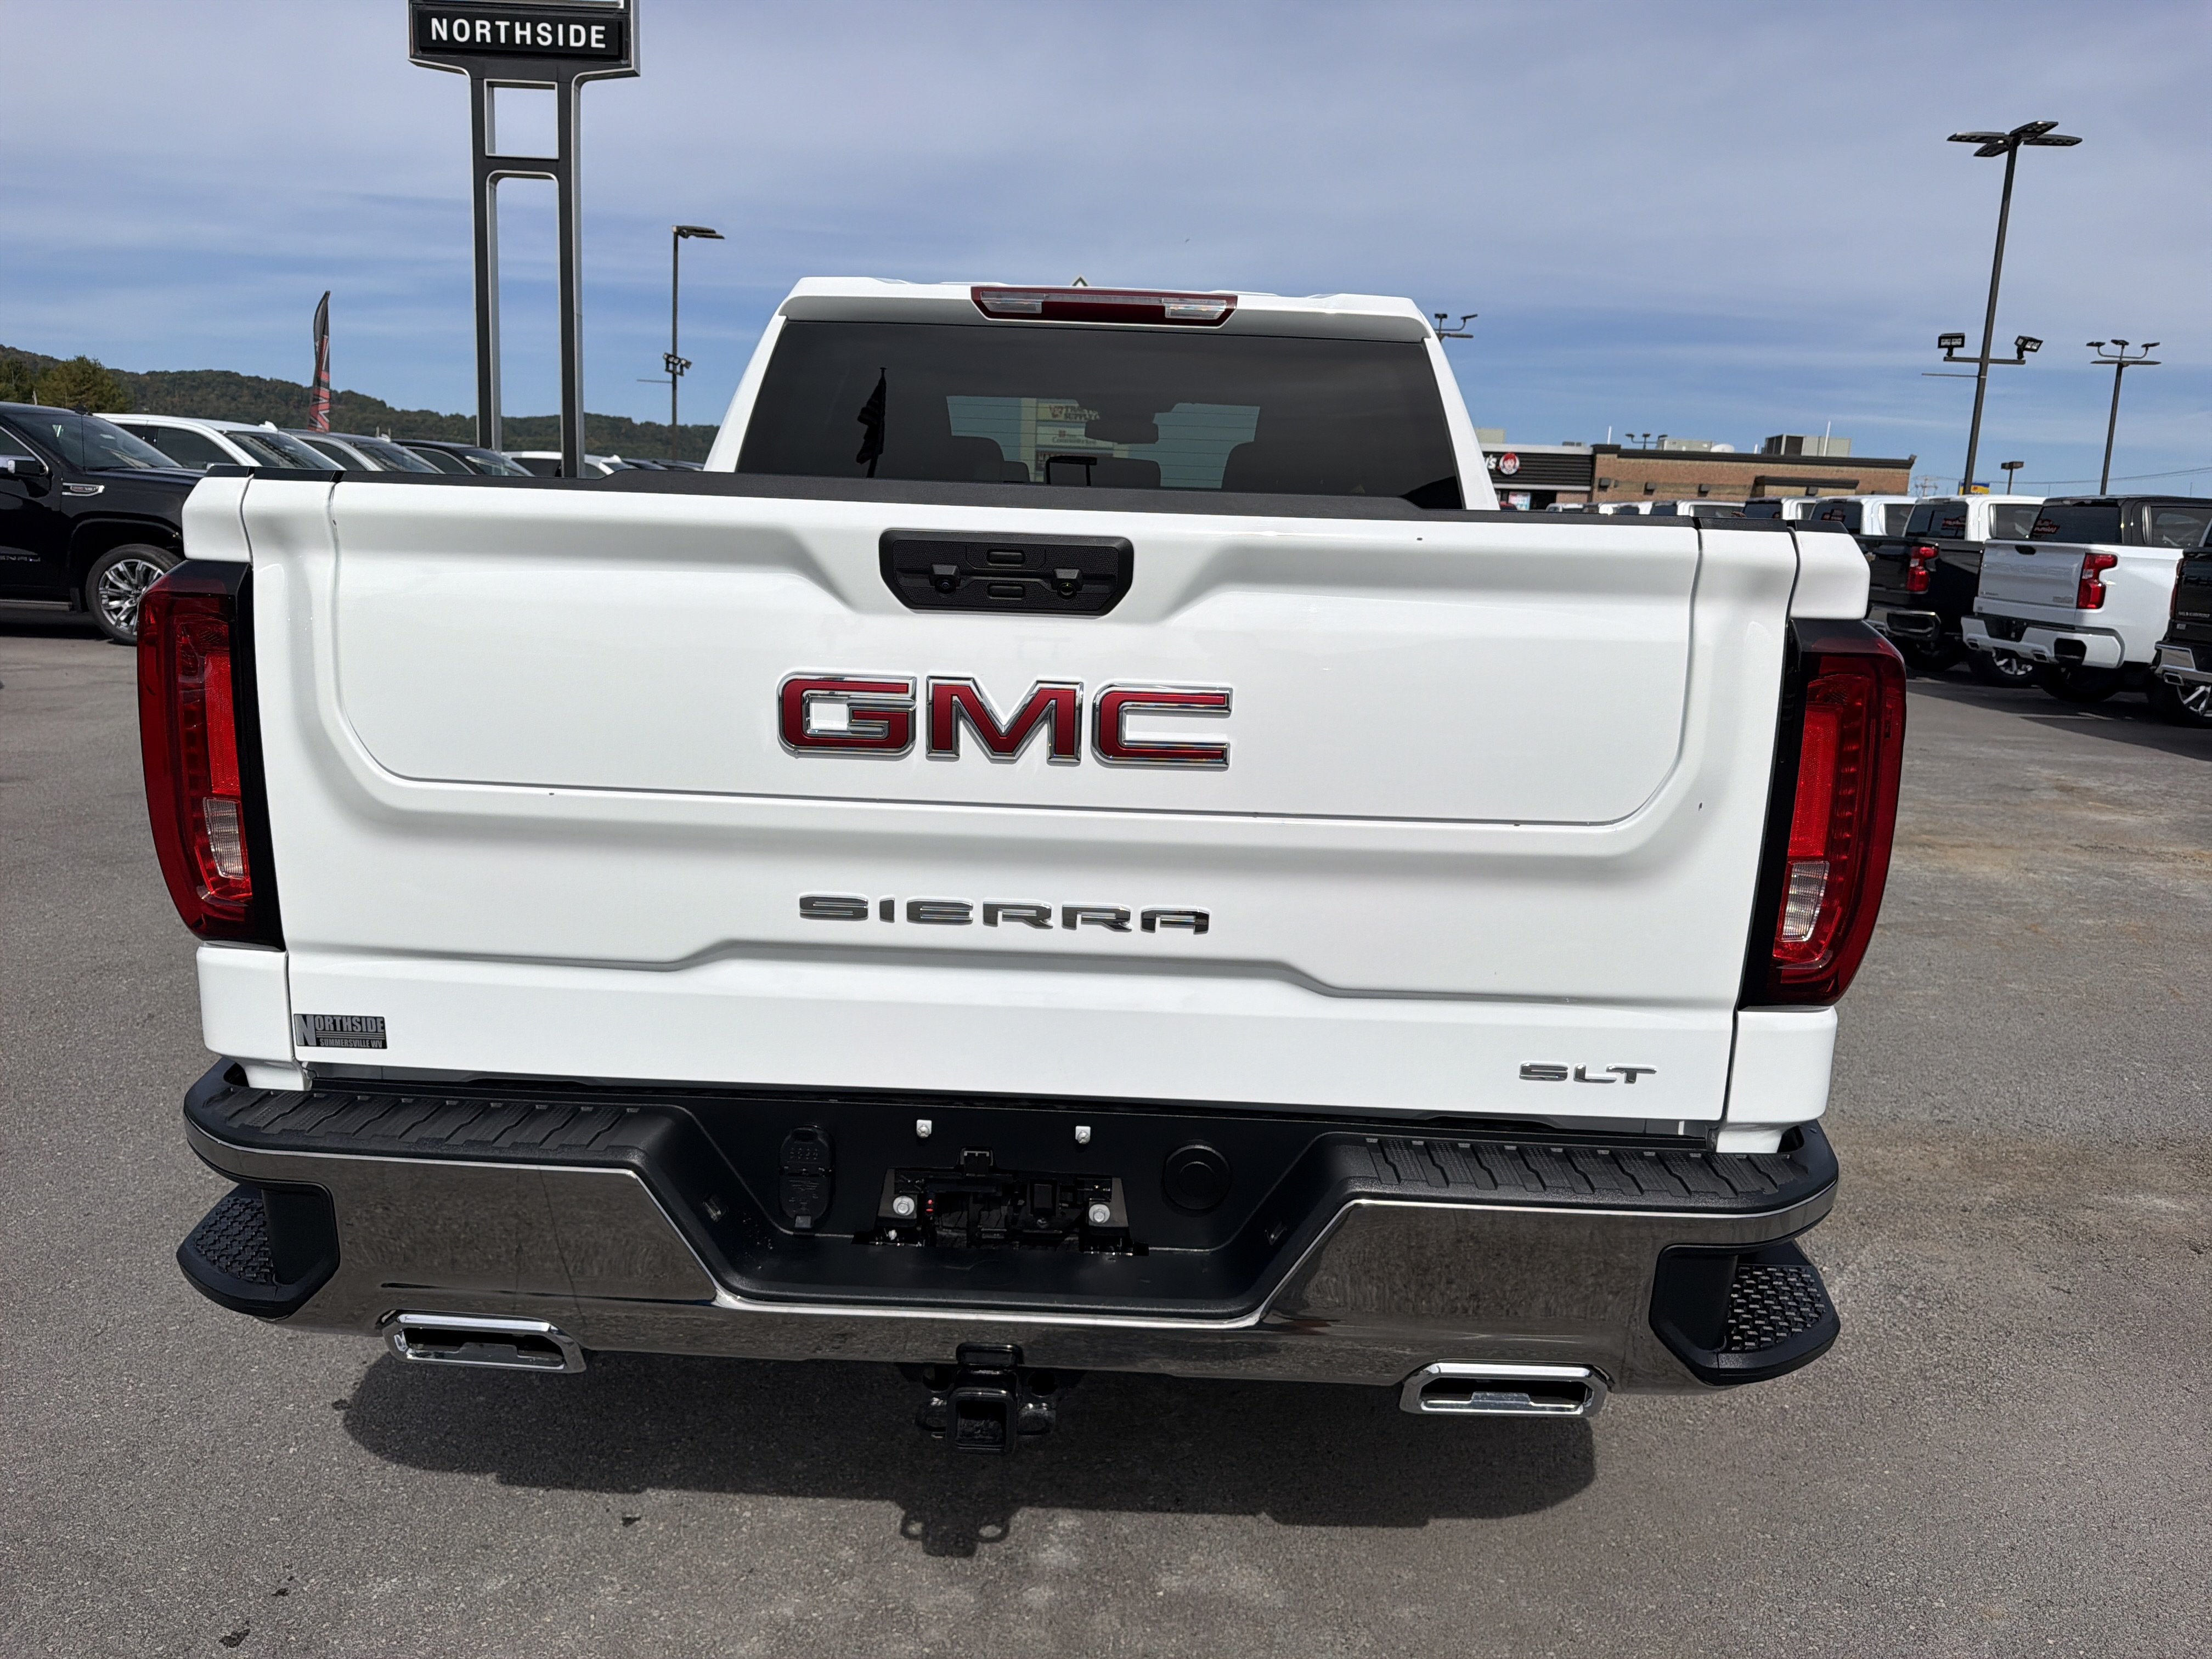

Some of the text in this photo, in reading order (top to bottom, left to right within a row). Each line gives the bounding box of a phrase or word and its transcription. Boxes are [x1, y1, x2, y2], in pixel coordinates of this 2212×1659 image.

[431, 18, 606, 49] NORTHSIDE
[777, 672, 1233, 768] GMC
[799, 894, 1210, 934] SIERRA
[294, 1014, 384, 1046] NORTHSIDE
[320, 1037, 382, 1048] SUMMERSVILLE WV
[1519, 1061, 1657, 1084] SLT
